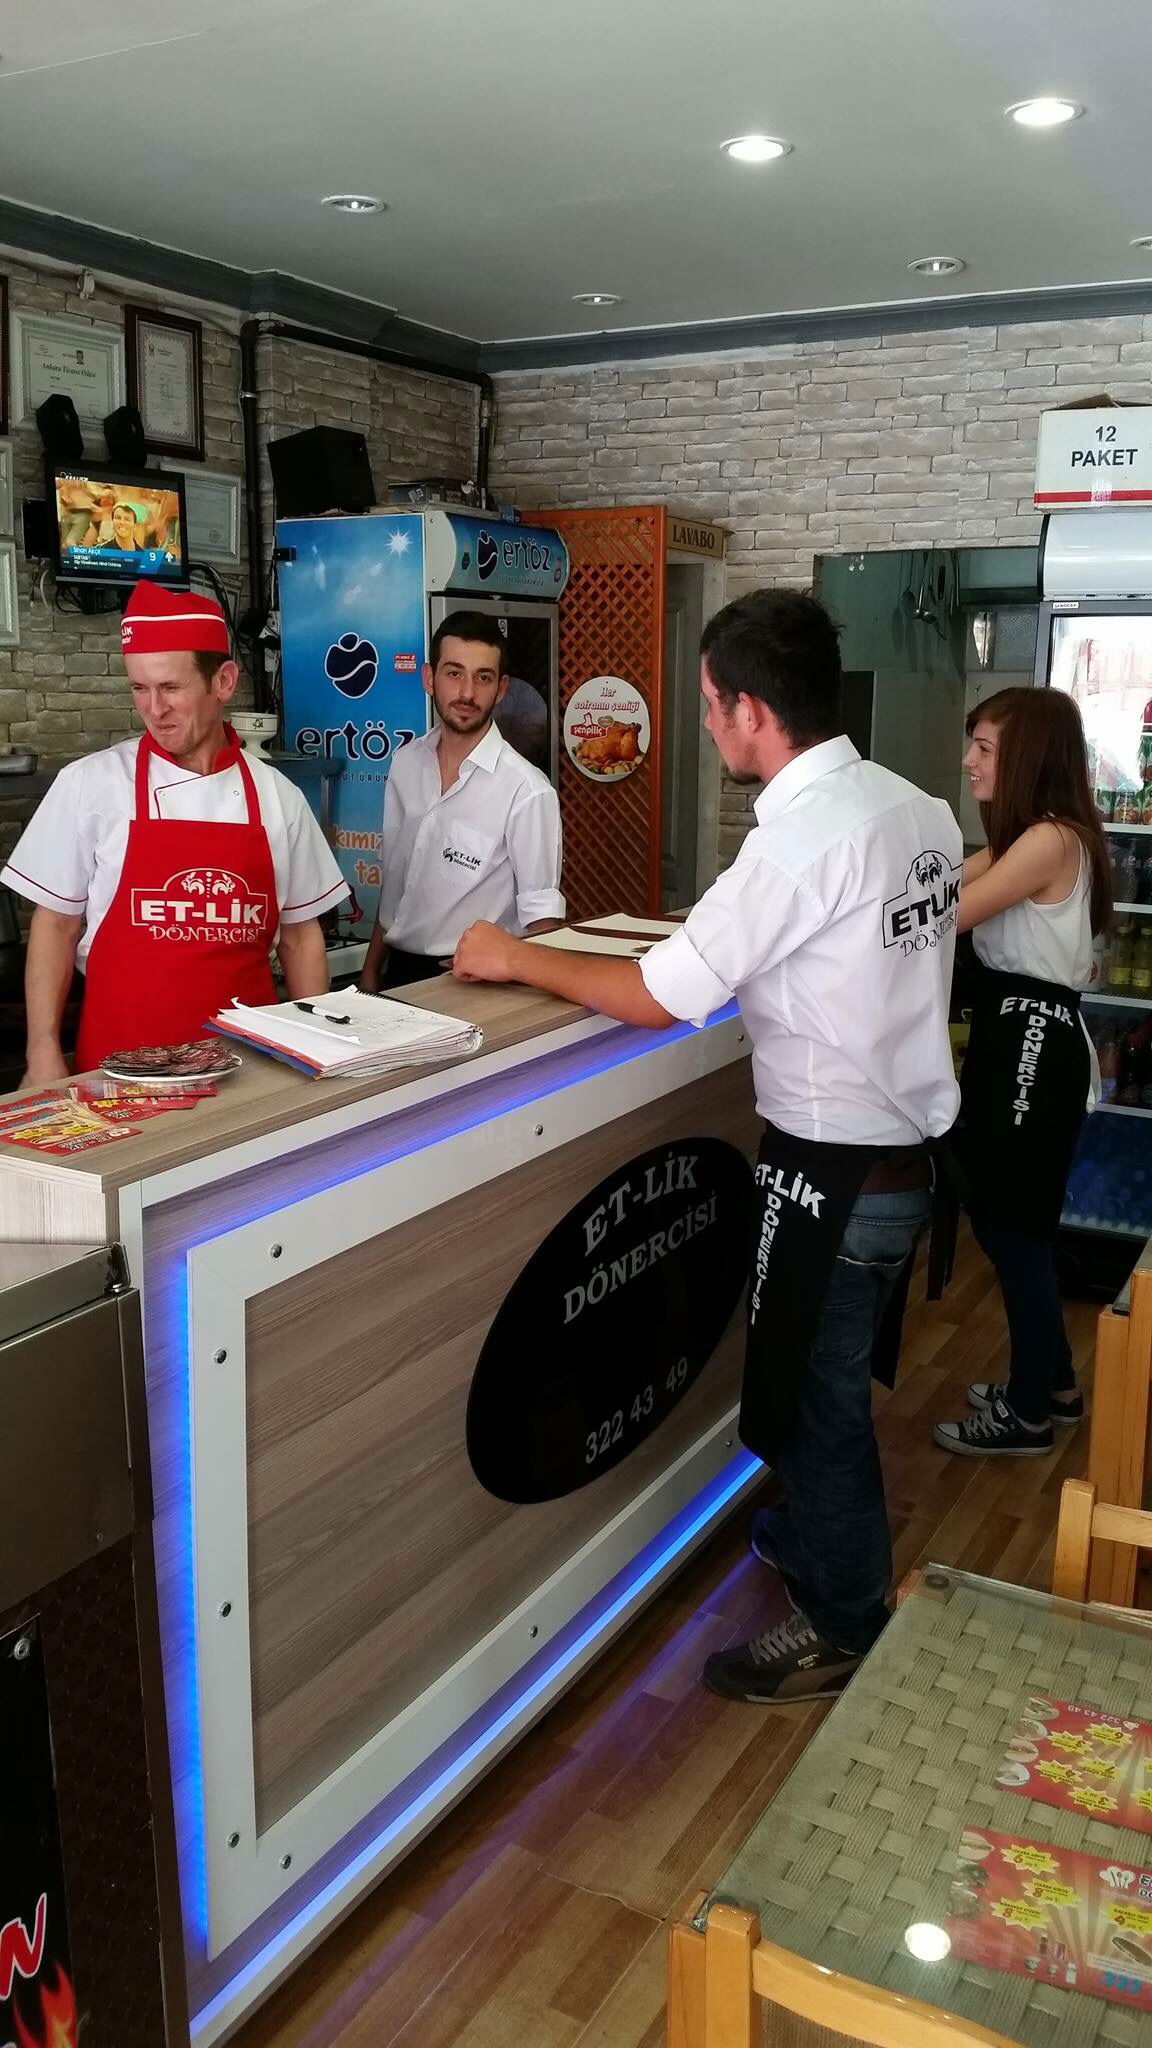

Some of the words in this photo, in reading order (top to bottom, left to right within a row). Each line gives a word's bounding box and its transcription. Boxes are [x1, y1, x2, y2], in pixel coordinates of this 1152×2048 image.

[1095, 425, 1117, 442] 12
[1071, 448, 1139, 467] PAKET
[673, 524, 715, 549] LAVABO
[149, 552, 156, 561] 9
[503, 536, 551, 572] ertöz
[600, 686, 617, 697] Her
[141, 898, 263, 925] ET-LİK
[149, 924, 260, 944] DÖNERCİSİ
[583, 1151, 699, 1257] ET-LİK
[755, 1163, 826, 1219] ET-LİK
[563, 1189, 718, 1325] DÖNERCİSİ
[585, 1409, 624, 1464] 322
[630, 1384, 654, 1422] 43
[666, 1356, 688, 1393] 49
